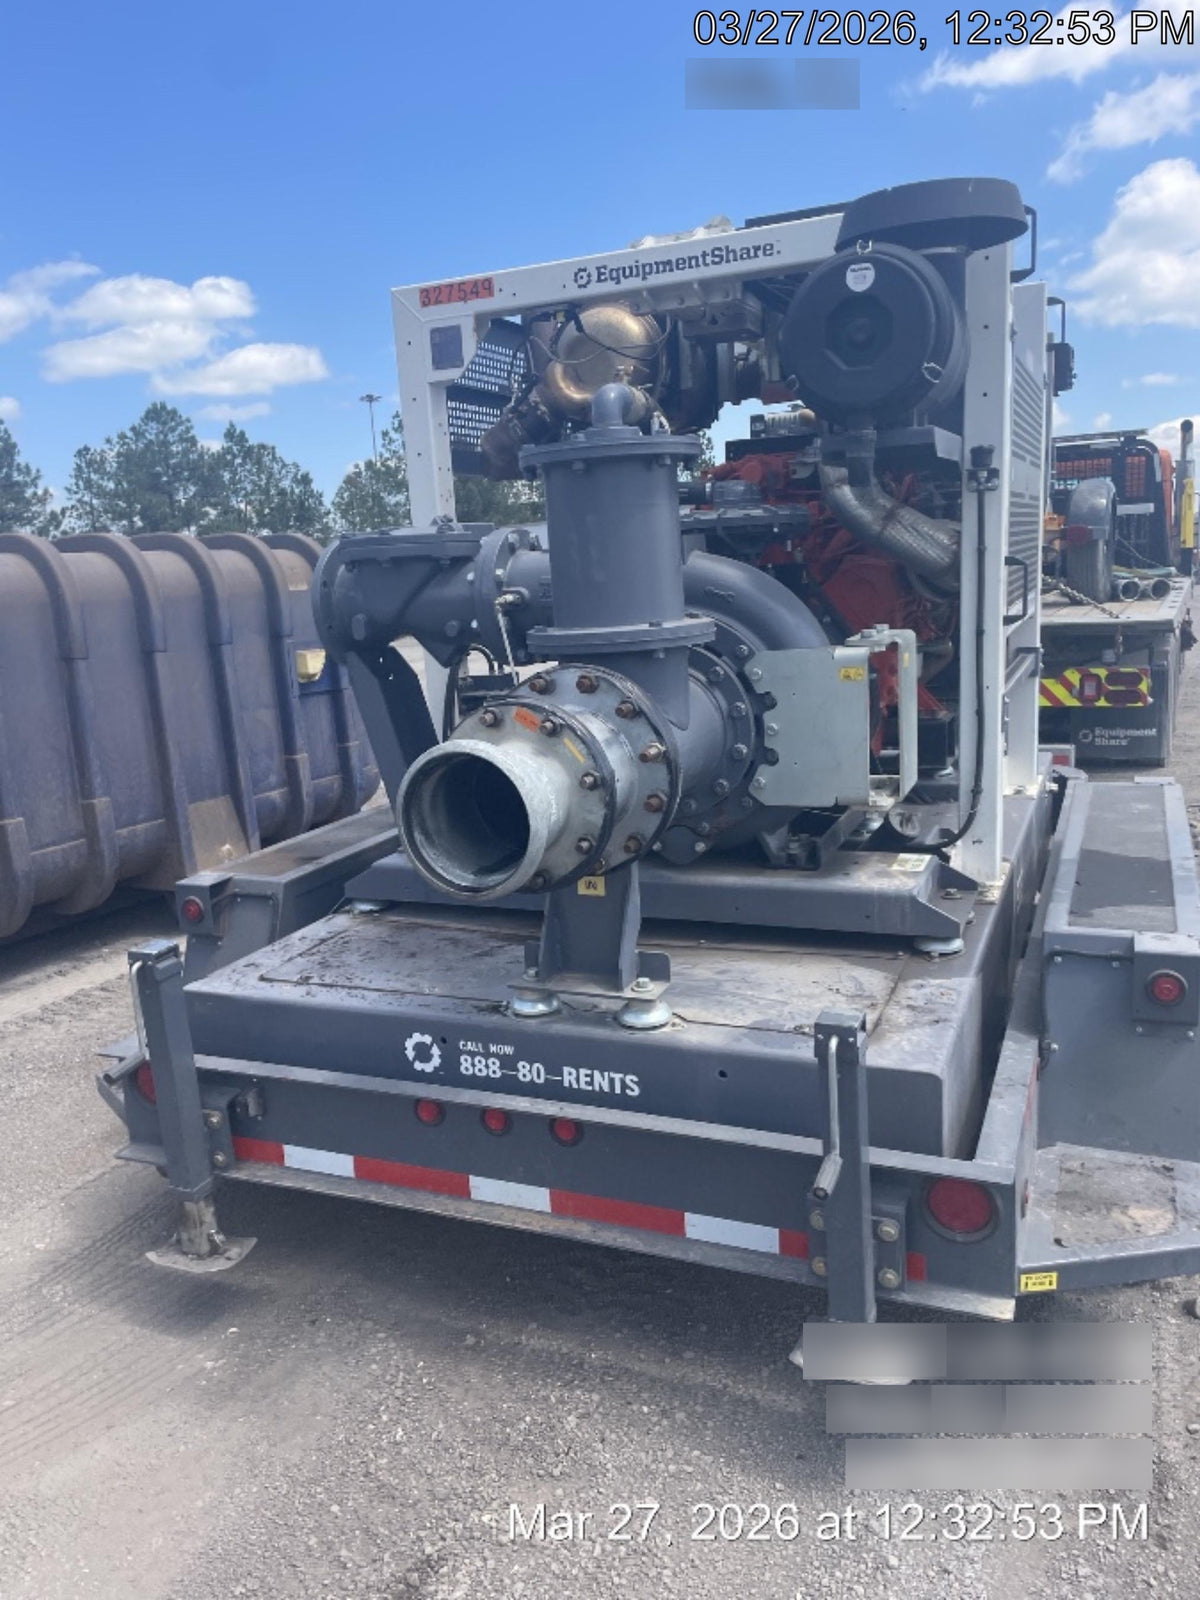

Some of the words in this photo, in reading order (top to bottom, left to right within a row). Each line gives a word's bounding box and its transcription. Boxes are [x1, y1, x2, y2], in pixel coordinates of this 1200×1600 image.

[595, 242, 775, 285] EquipmentShare
[421, 278, 493, 307] 327549
[1095, 727, 1157, 738] Equipment
[459, 1040, 484, 1053] CALL
[489, 1043, 515, 1056] NOW
